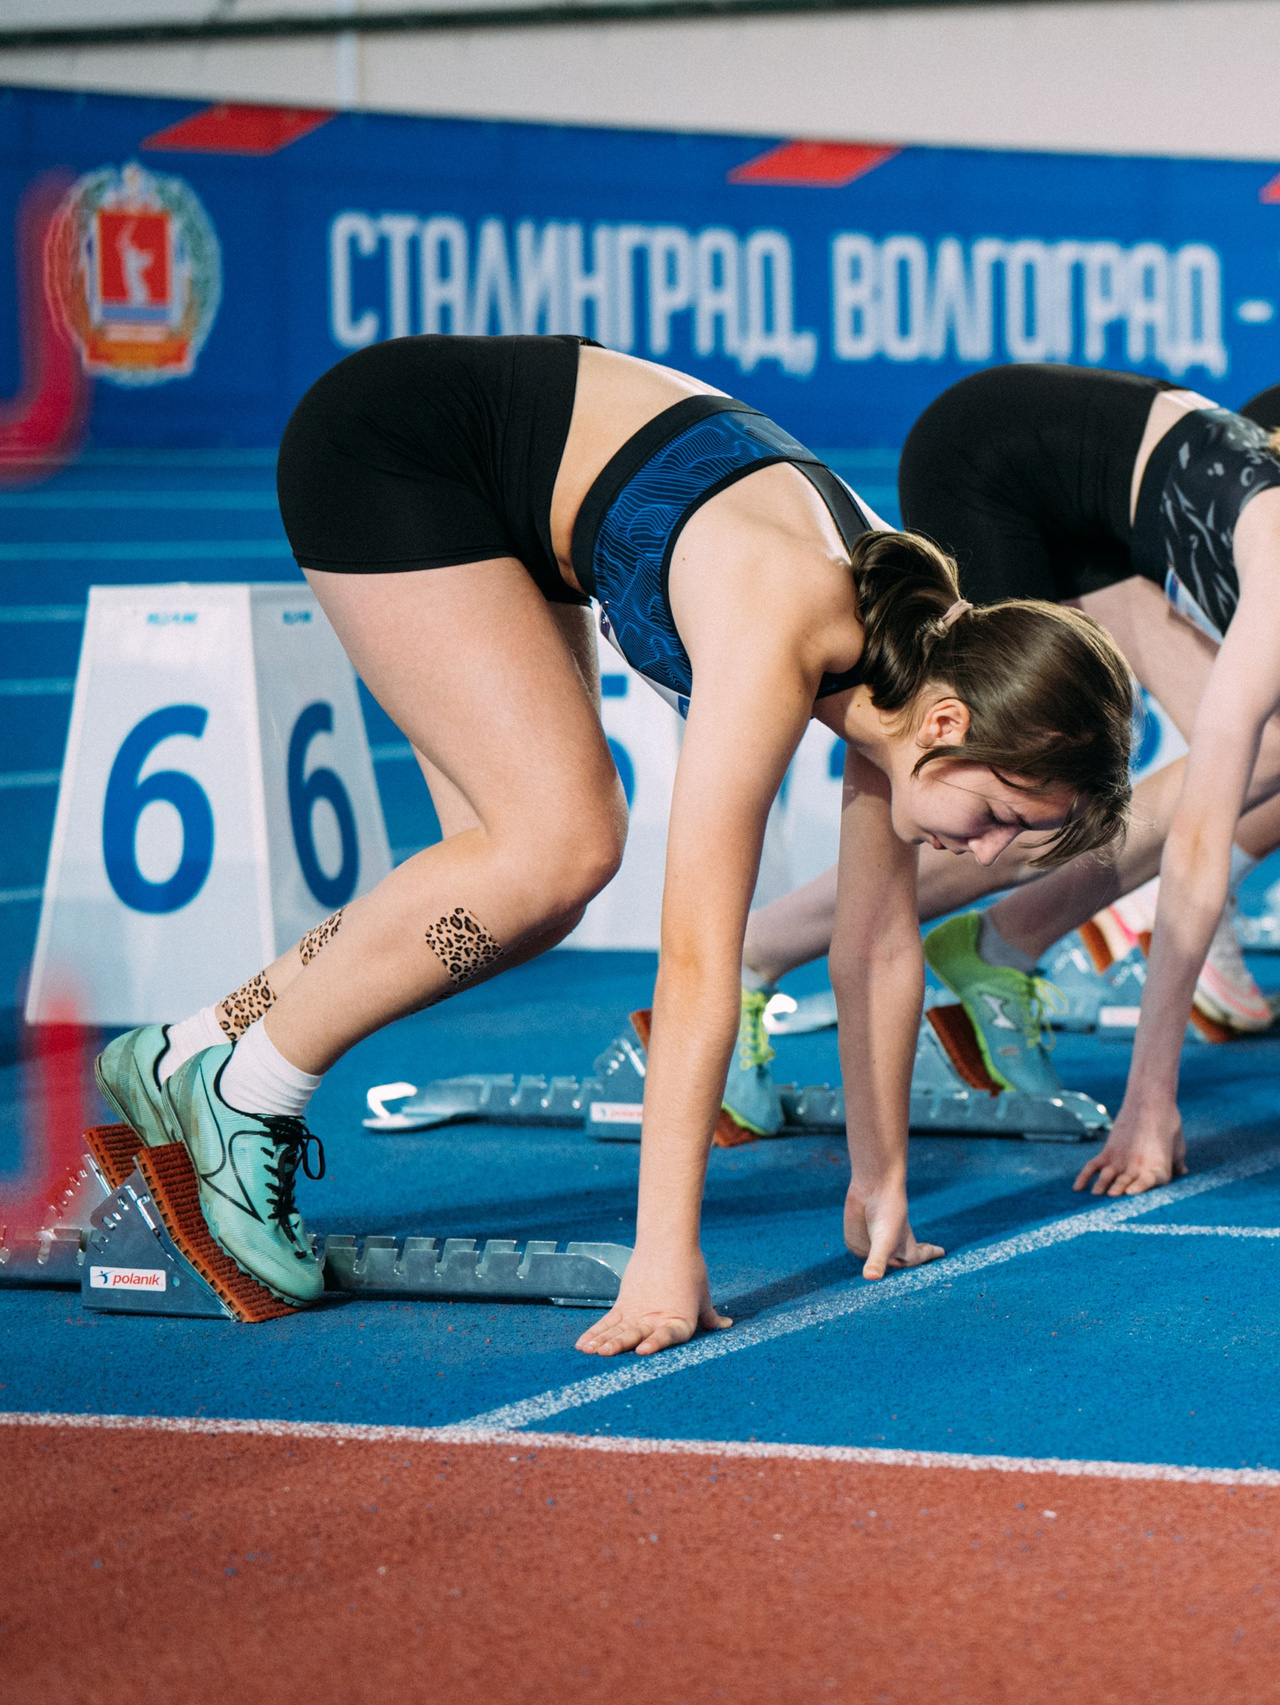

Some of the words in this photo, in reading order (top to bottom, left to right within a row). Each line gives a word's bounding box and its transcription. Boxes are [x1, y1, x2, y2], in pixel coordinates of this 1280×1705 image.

[330, 210, 817, 377] СТАЛИНГРАД,
[831, 235, 1228, 376] ВОЛГОГРАД
[103, 704, 214, 914] 6
[288, 702, 359, 908] 6
[112, 1272, 160, 1286] polanik
